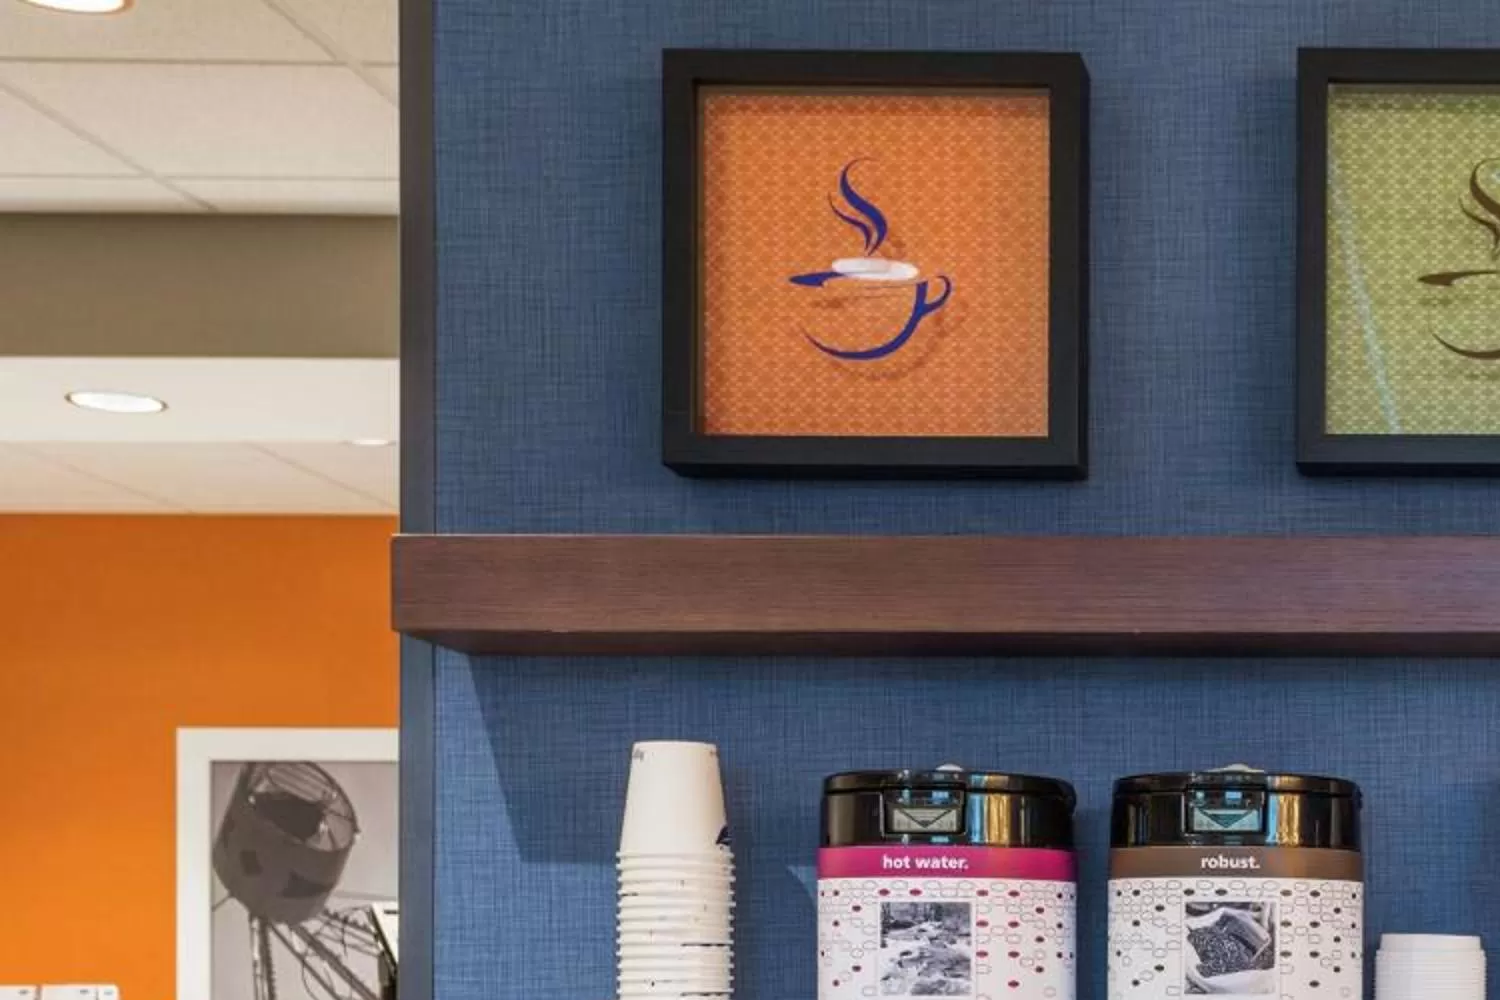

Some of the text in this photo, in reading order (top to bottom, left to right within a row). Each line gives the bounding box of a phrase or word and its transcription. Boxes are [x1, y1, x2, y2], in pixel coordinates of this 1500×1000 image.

[883, 854, 969, 870] hot water.
[1201, 854, 1260, 869] robust.
